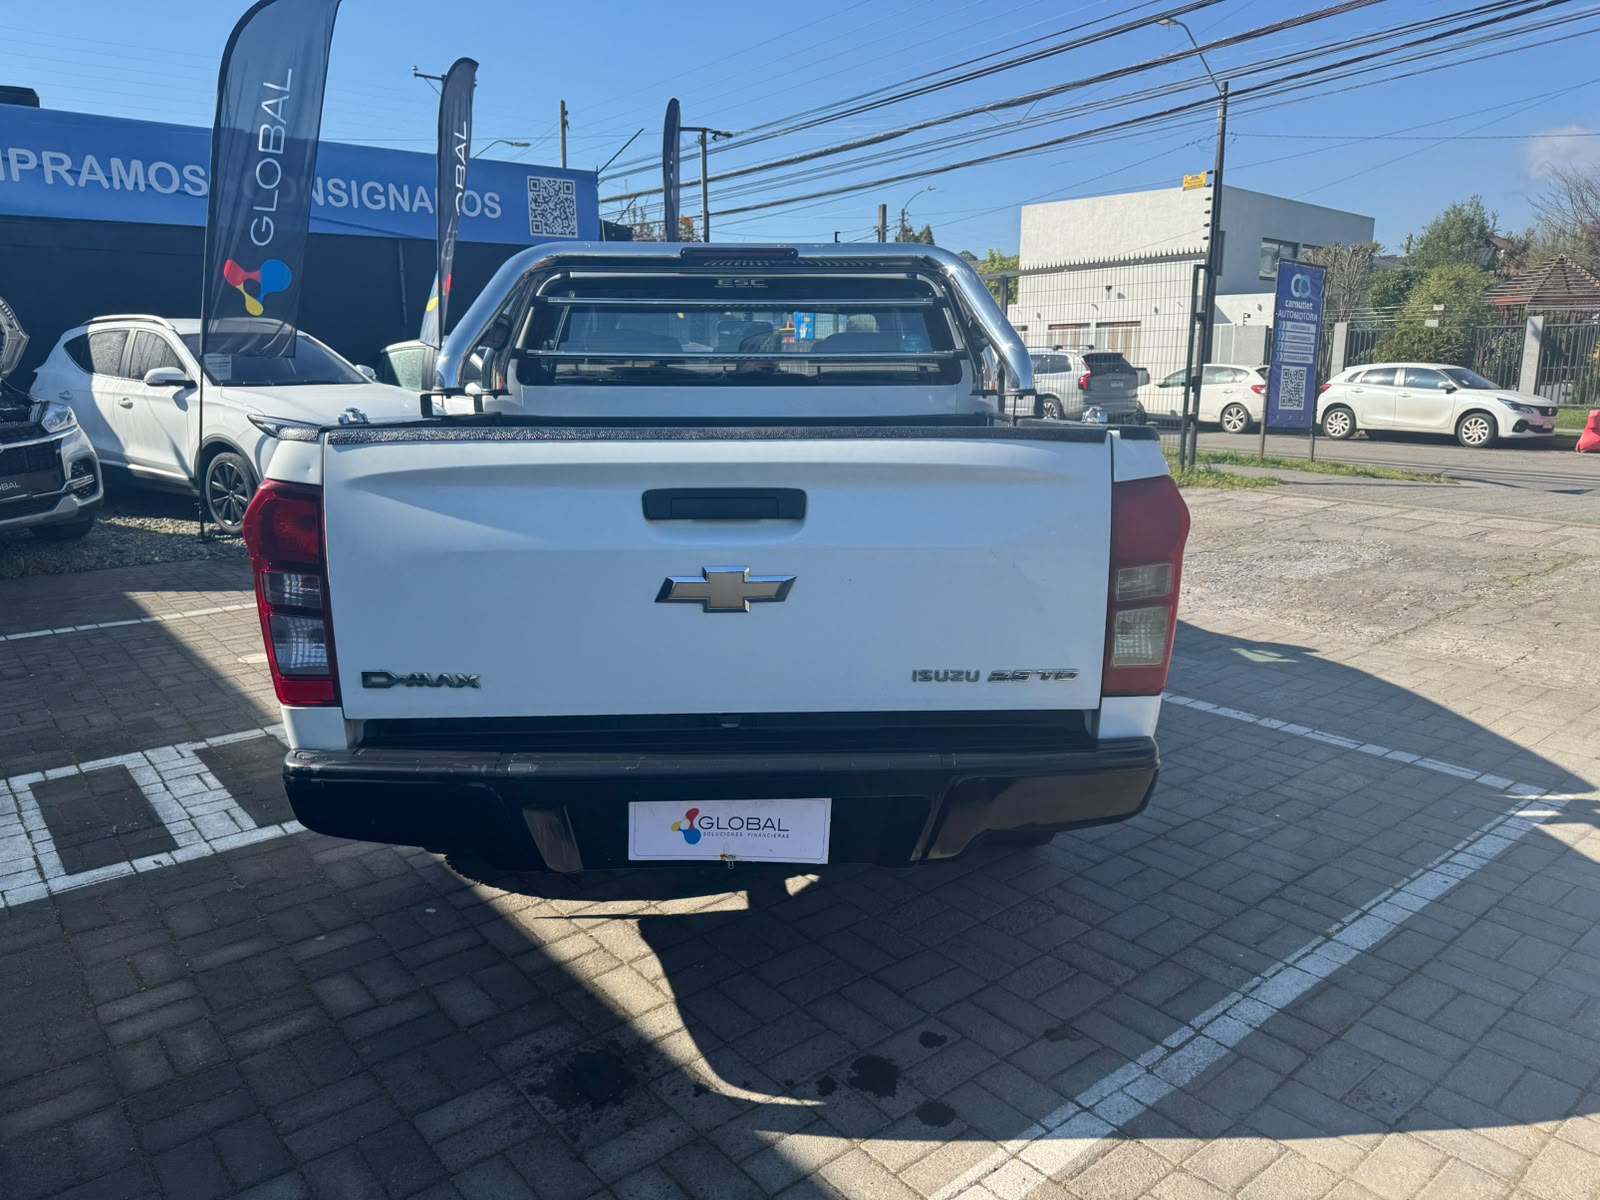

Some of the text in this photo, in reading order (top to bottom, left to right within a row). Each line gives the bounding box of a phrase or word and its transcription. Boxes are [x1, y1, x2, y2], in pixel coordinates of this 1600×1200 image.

[250, 67, 293, 247] GLOBAL
[0, 147, 209, 197] PRAMOS
[1285, 300, 1313, 310] caroutlet
[1278, 310, 1317, 321] AUTOMOTORA
[360, 671, 481, 689] D-MAX
[912, 669, 980, 682] ISUZU
[698, 816, 790, 832] GLOBAL
